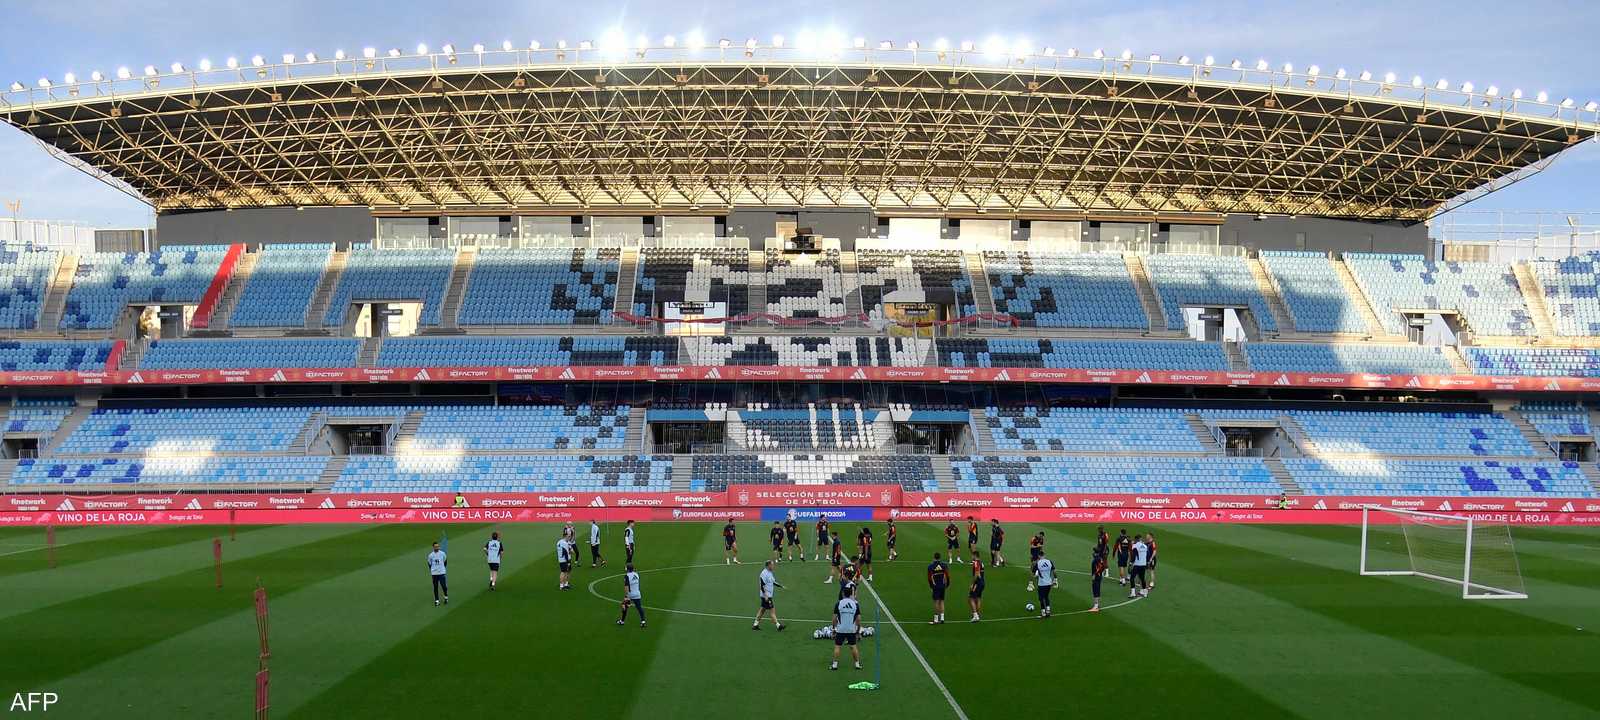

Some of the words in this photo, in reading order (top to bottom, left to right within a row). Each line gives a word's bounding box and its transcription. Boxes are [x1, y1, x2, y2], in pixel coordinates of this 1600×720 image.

[756, 489, 814, 498] SELECCIÓN
[818, 489, 871, 498] ESPAÑOLA
[57, 513, 83, 522] VINO
[86, 513, 99, 522] DE
[102, 513, 115, 522] LA
[118, 513, 146, 522] ROJA
[422, 511, 448, 519] VINO
[451, 511, 465, 519] DE
[468, 511, 481, 519] LA
[485, 511, 513, 519] ROJA
[1120, 511, 1145, 519] VINO
[1148, 511, 1162, 520] DE
[1164, 511, 1178, 520] LA
[1180, 511, 1207, 520] ROJA
[1495, 514, 1507, 522] DE
[1510, 514, 1523, 522] LA
[1525, 514, 1550, 522] ROJA
